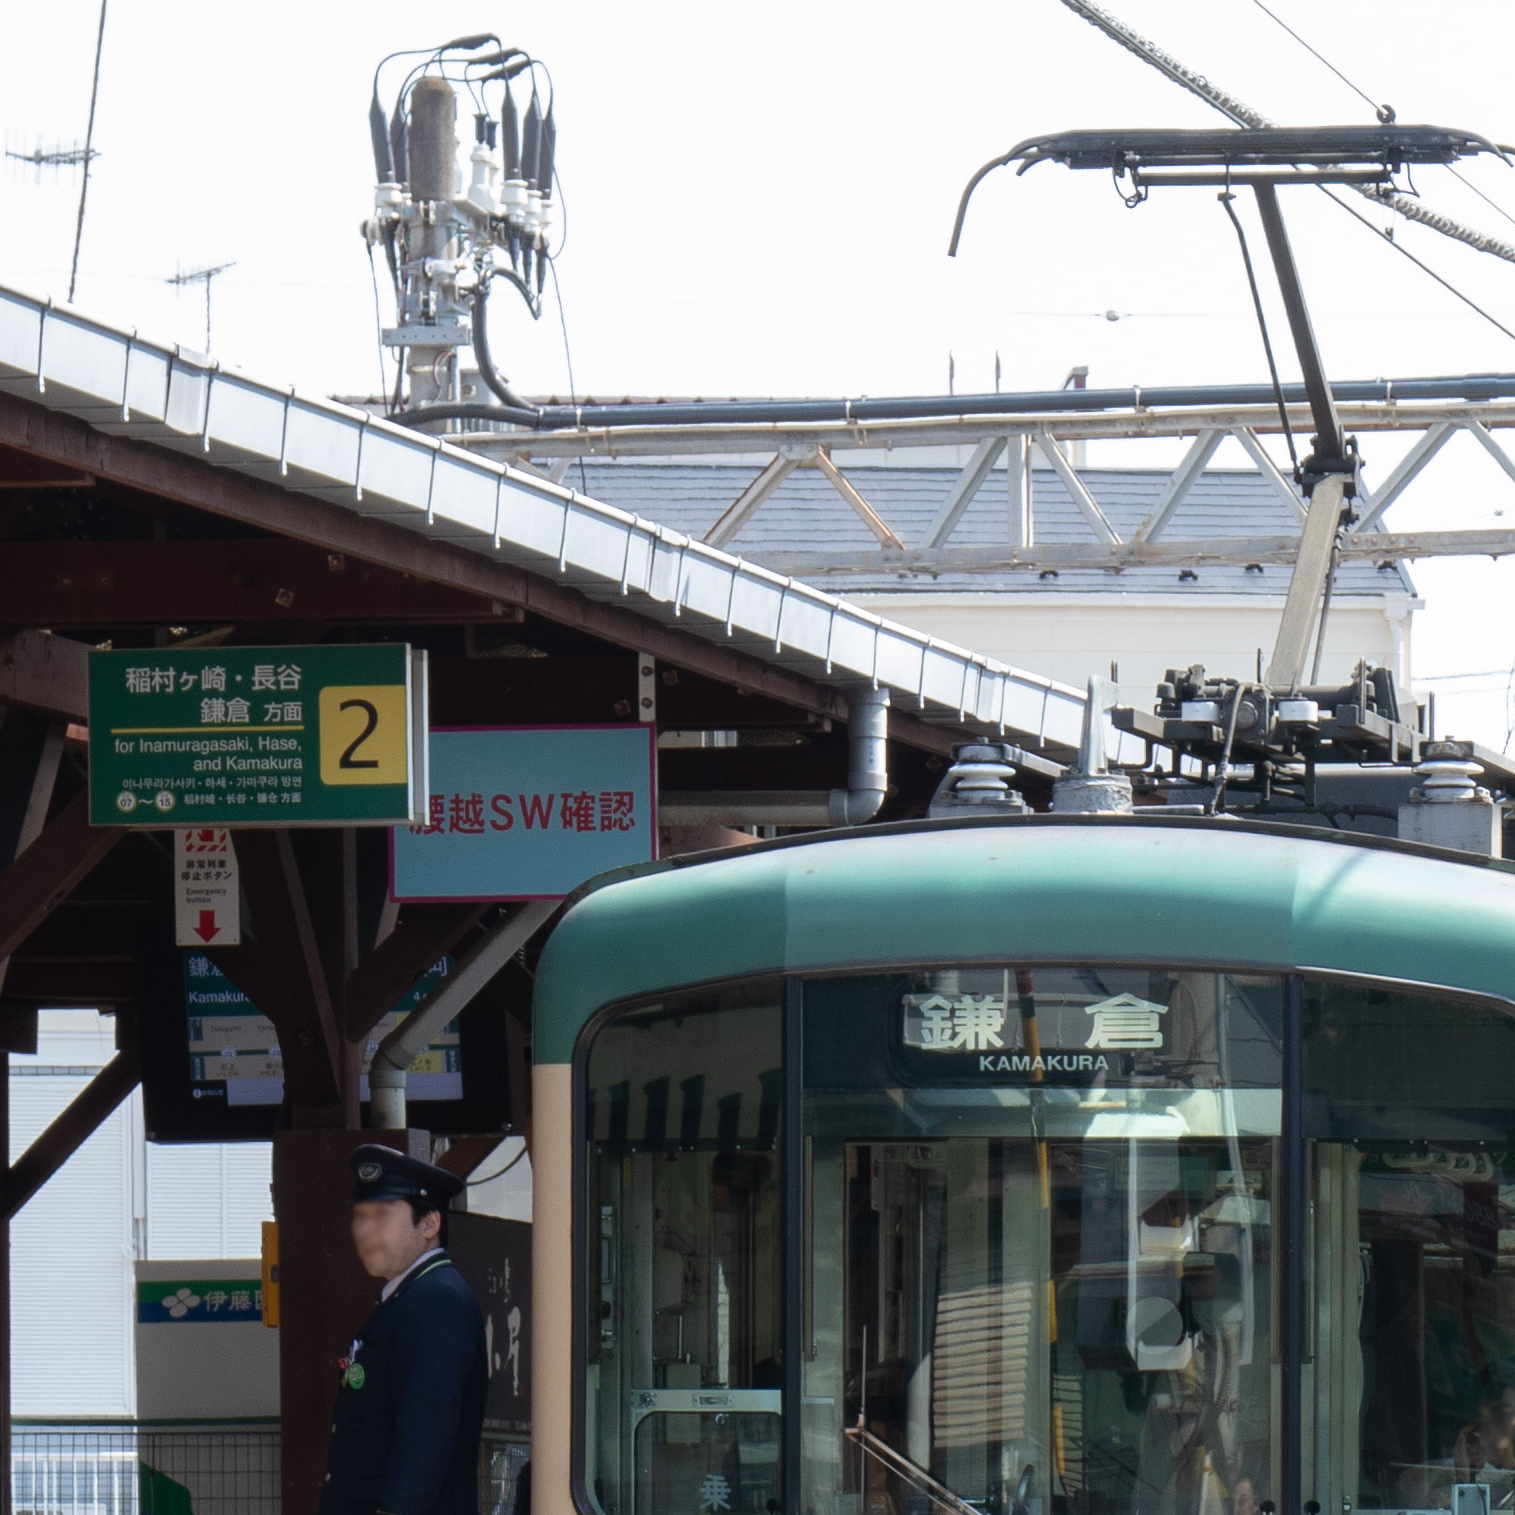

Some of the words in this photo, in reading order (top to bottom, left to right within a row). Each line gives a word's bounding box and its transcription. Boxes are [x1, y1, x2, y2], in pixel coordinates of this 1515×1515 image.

[200, 697, 250, 723] 鎌倉
[263, 702, 302, 723] 方面
[338, 698, 379, 769] 2
[115, 739, 134, 753] for
[139, 738, 253, 755] Inamuragasaki,
[259, 737, 301, 753] Hase,
[193, 757, 221, 771] and
[226, 756, 302, 771] Kamakura
[919, 993, 1168, 1050] 鎌倉
[979, 1055, 1109, 1071] KAMAKURA
